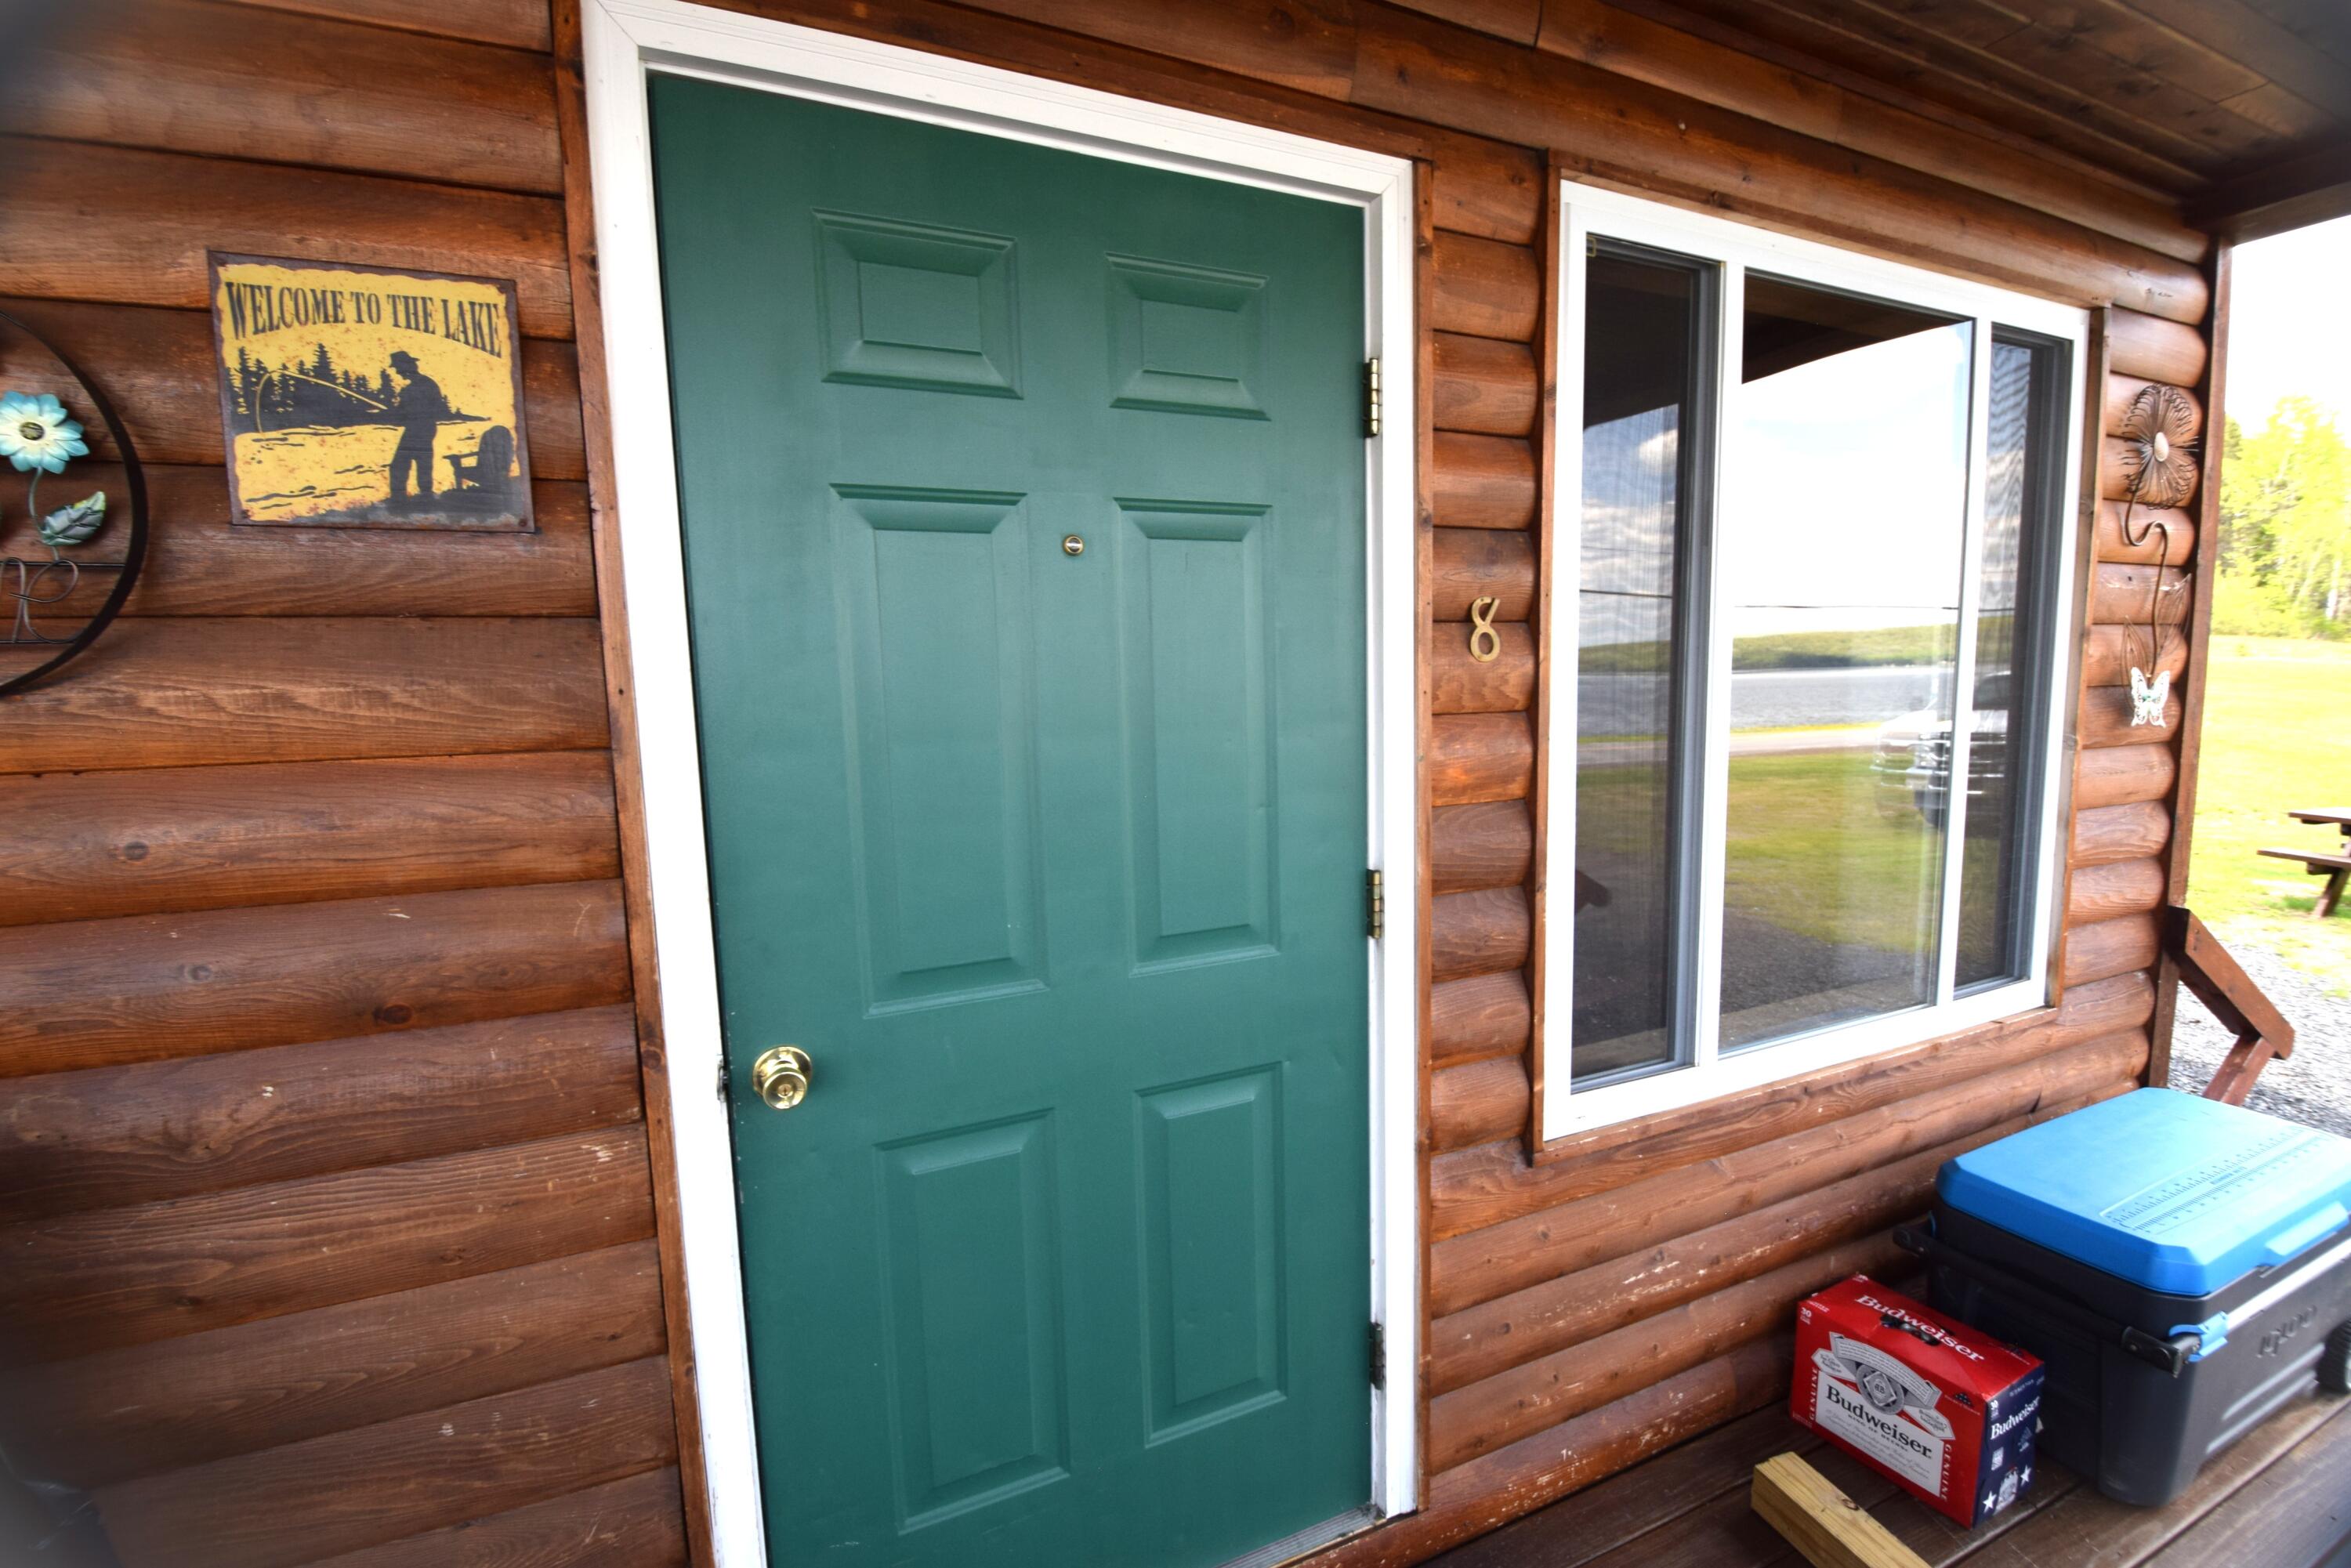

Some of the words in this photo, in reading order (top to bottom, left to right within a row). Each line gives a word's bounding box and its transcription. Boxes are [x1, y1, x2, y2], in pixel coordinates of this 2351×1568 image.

[225, 281, 346, 340] WELCOME
[350, 292, 381, 324] TO
[387, 294, 436, 335] THE
[441, 299, 502, 359] LAKE
[1470, 596, 1501, 662] 8
[1855, 1295, 1985, 1362] Budweiser
[1826, 1384, 1933, 1458] Budweiser
[1991, 1396, 2041, 1440] Budweiser
[1941, 1443, 1952, 1501] GENUINE
